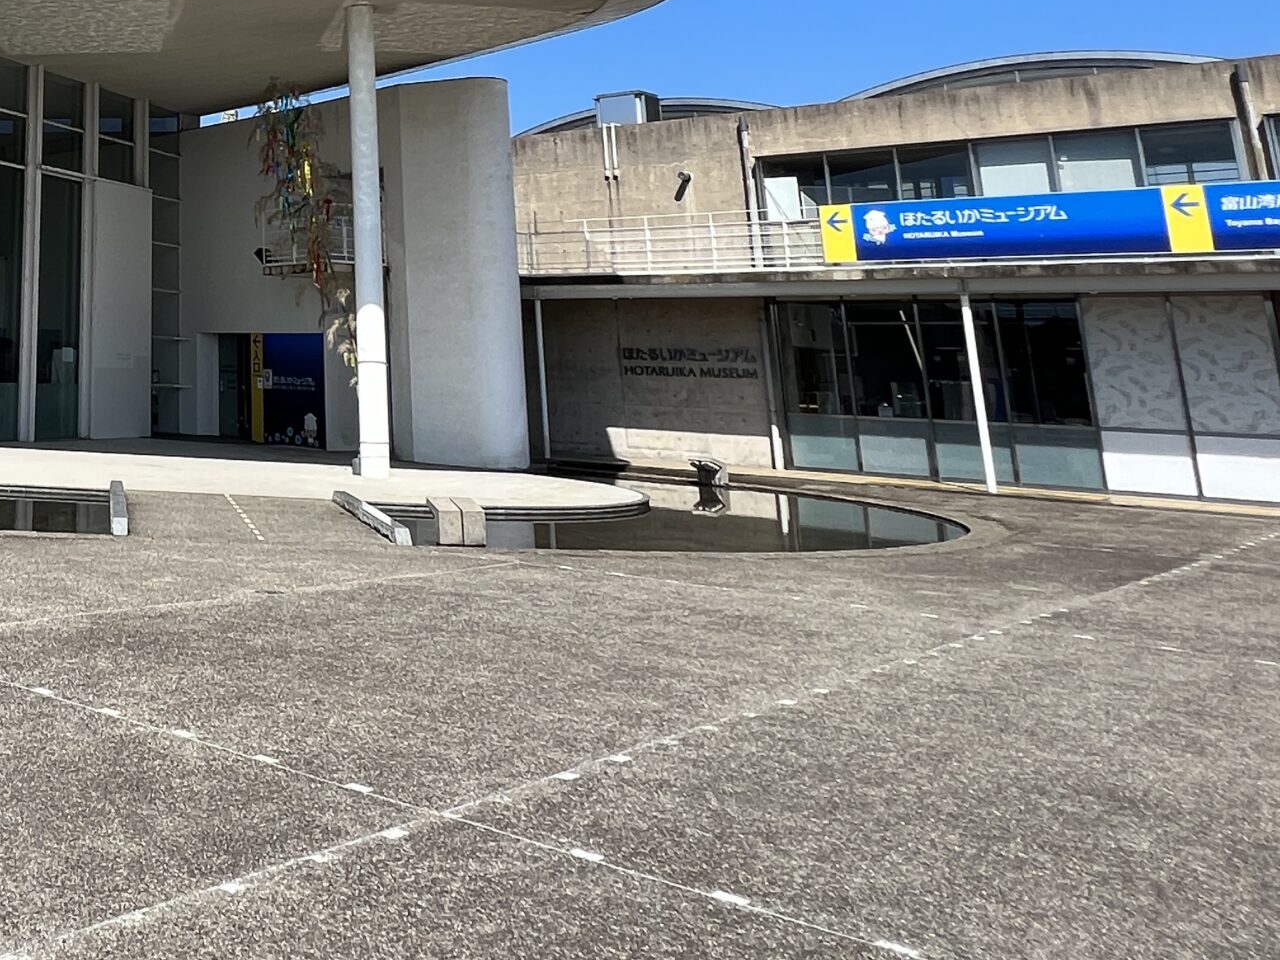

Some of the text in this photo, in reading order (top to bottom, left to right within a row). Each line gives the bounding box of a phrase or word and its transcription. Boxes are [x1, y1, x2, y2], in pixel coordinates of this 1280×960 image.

[899, 205, 1068, 227] ほたるいかミュージアム
[902, 230, 949, 240] HOTARUIKA
[252, 349, 261, 373] 入口
[622, 347, 758, 363] ほたるいかミュージアム
[623, 365, 759, 379] HOTARUIKA MUSEUM
